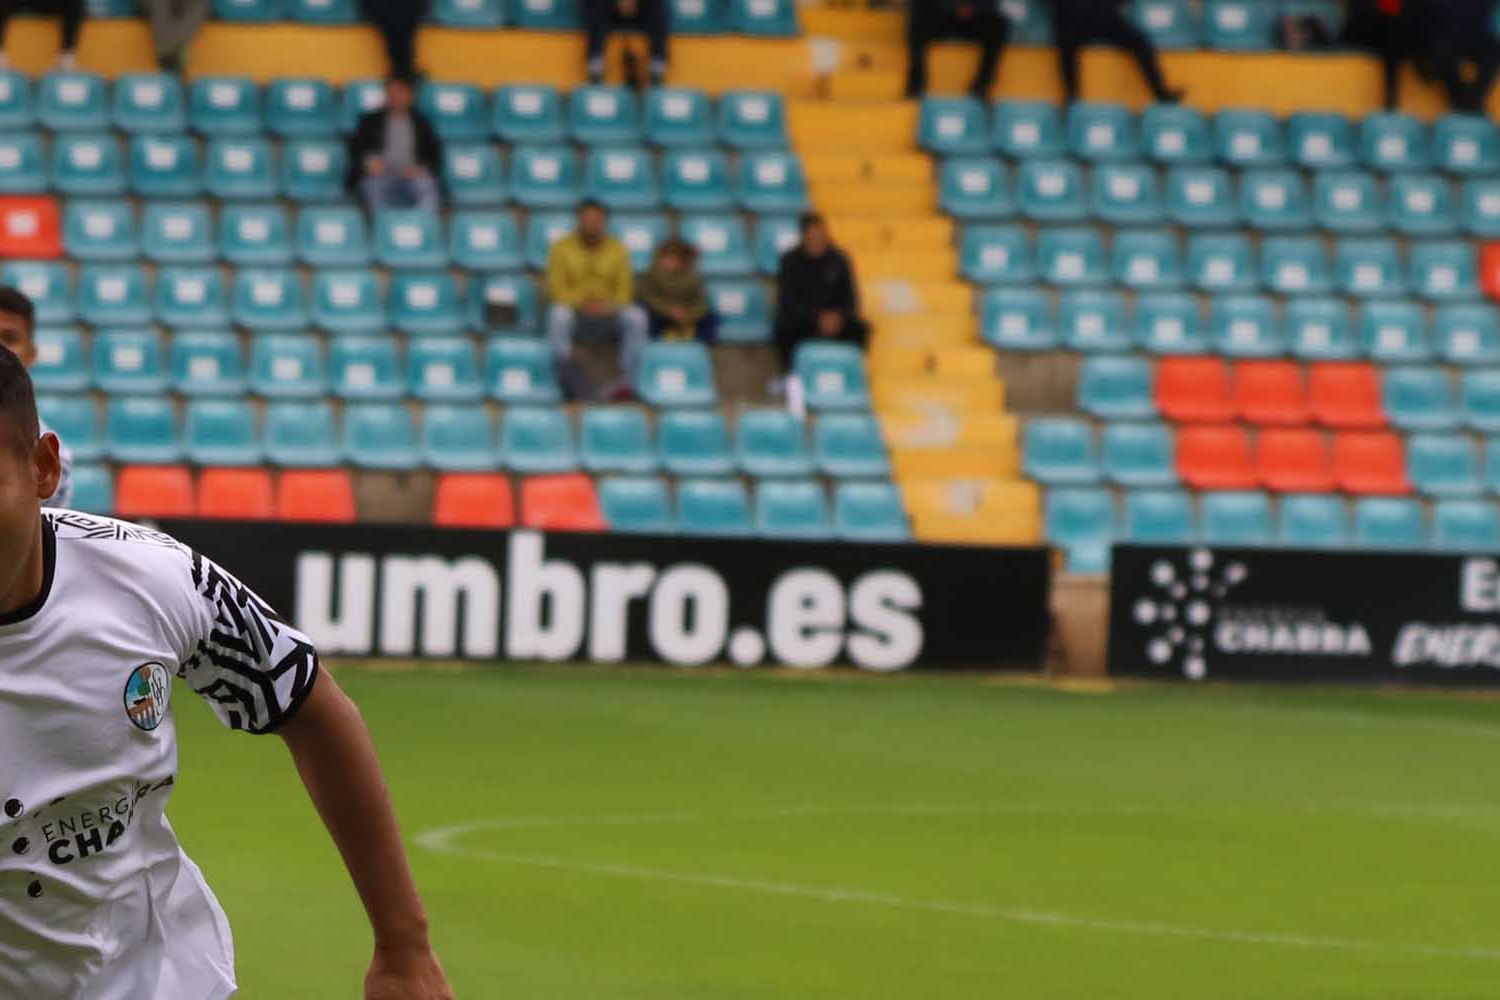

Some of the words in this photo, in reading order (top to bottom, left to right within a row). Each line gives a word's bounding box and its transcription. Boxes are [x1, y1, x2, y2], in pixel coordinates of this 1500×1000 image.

[297, 530, 924, 670] umbro.es
[41, 796, 131, 843] ENERG
[48, 815, 127, 865] CHA
